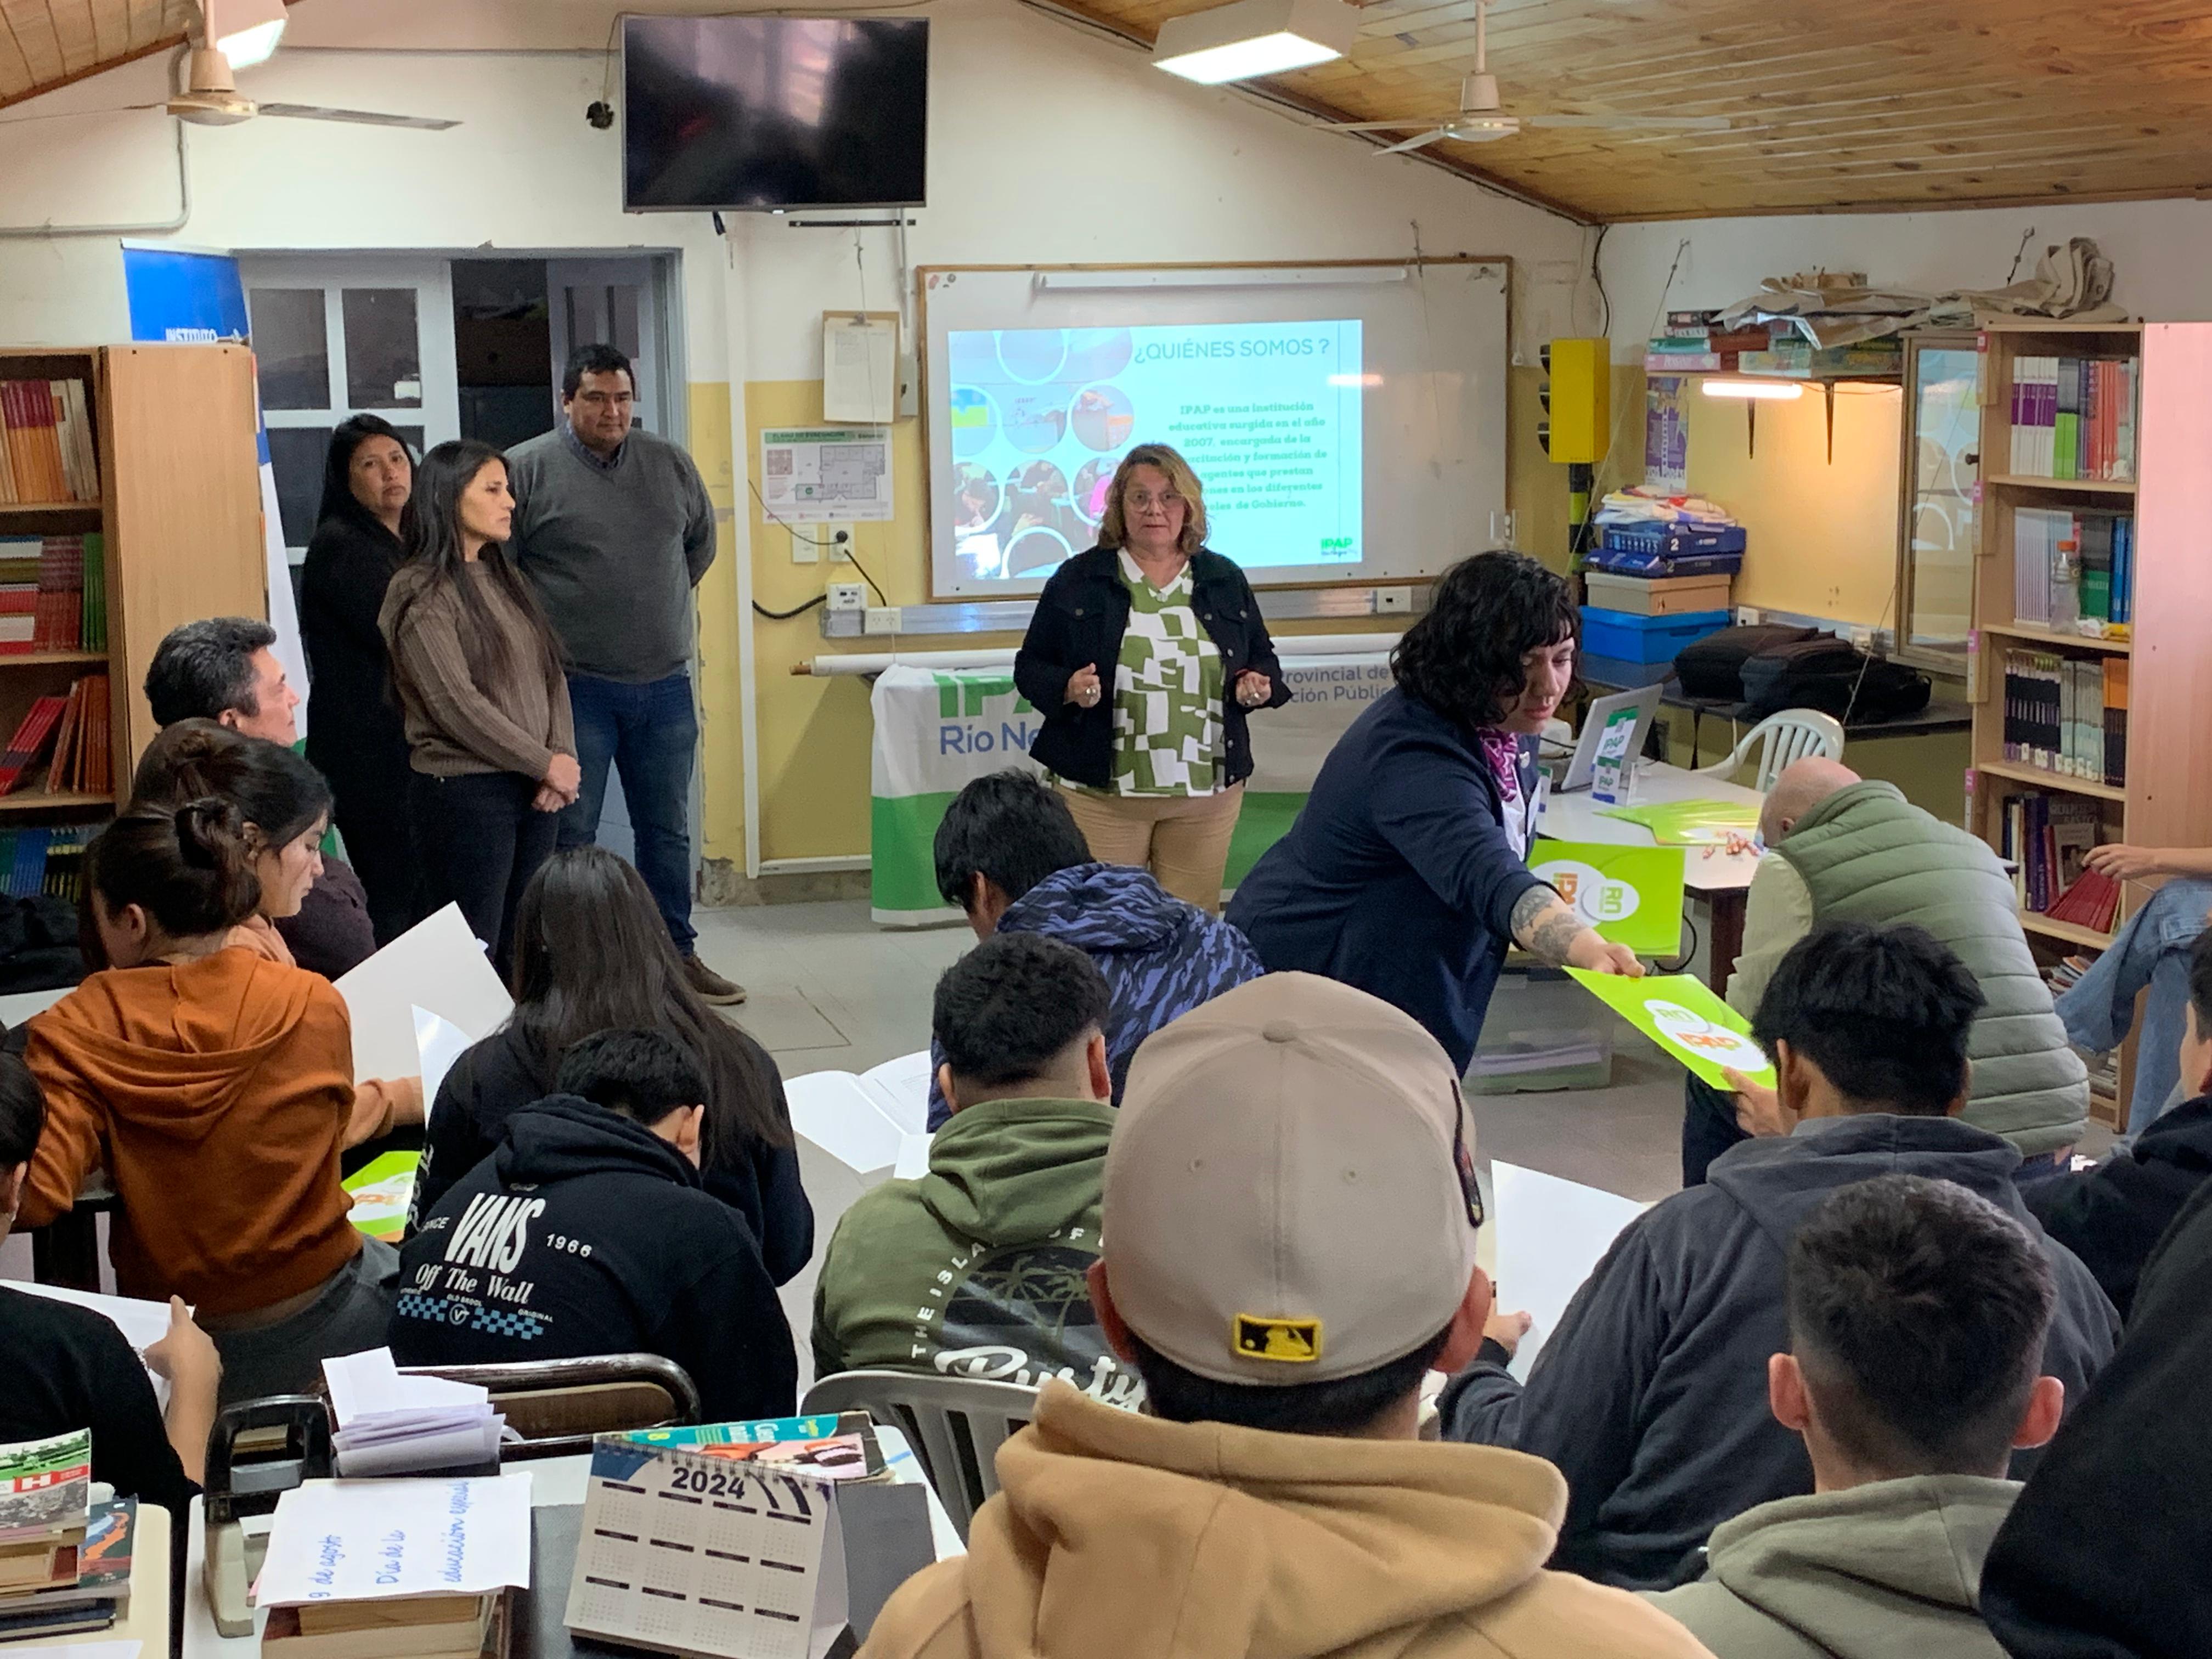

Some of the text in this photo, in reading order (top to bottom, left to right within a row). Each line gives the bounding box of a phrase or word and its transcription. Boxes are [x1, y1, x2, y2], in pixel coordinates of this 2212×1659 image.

[1134, 338, 1235, 363] ¿QUIÉNES
[1240, 338, 1313, 357] SOMOS
[1180, 405, 1211, 414] IPAP
[1252, 402, 1314, 413] institución
[1169, 417, 1326, 432] educativa surgida en el año
[1220, 434, 1282, 447] encargada
[1284, 433, 1297, 443] de
[1300, 433, 1311, 443] la
[1244, 454, 1251, 464] y
[1253, 450, 1312, 461] formación
[1314, 449, 1328, 459] de
[1200, 467, 1313, 481] agentes que prestan
[1246, 484, 1262, 493] los
[1265, 483, 1323, 493] diferentes
[1236, 500, 1249, 509] de
[1251, 499, 1306, 509] Gobierno.
[1321, 538, 1352, 549] IPAP
[1671, 538, 1679, 551] 2
[1283, 664, 1390, 684] rovincial de
[940, 724, 995, 755] Río
[444, 1193, 546, 1274] VANS
[546, 1233, 592, 1258] 1966
[415, 1263, 534, 1304] Off The Wall
[517, 1308, 554, 1323] ORIGINAL
[21, 1473, 52, 1490] H
[672, 1467, 746, 1499] 2024
[318, 1534, 346, 1567] agosto
[377, 1544, 404, 1558] de
[437, 1517, 466, 1583] educación
[308, 1568, 335, 1585] de
[376, 1560, 402, 1584] Día
